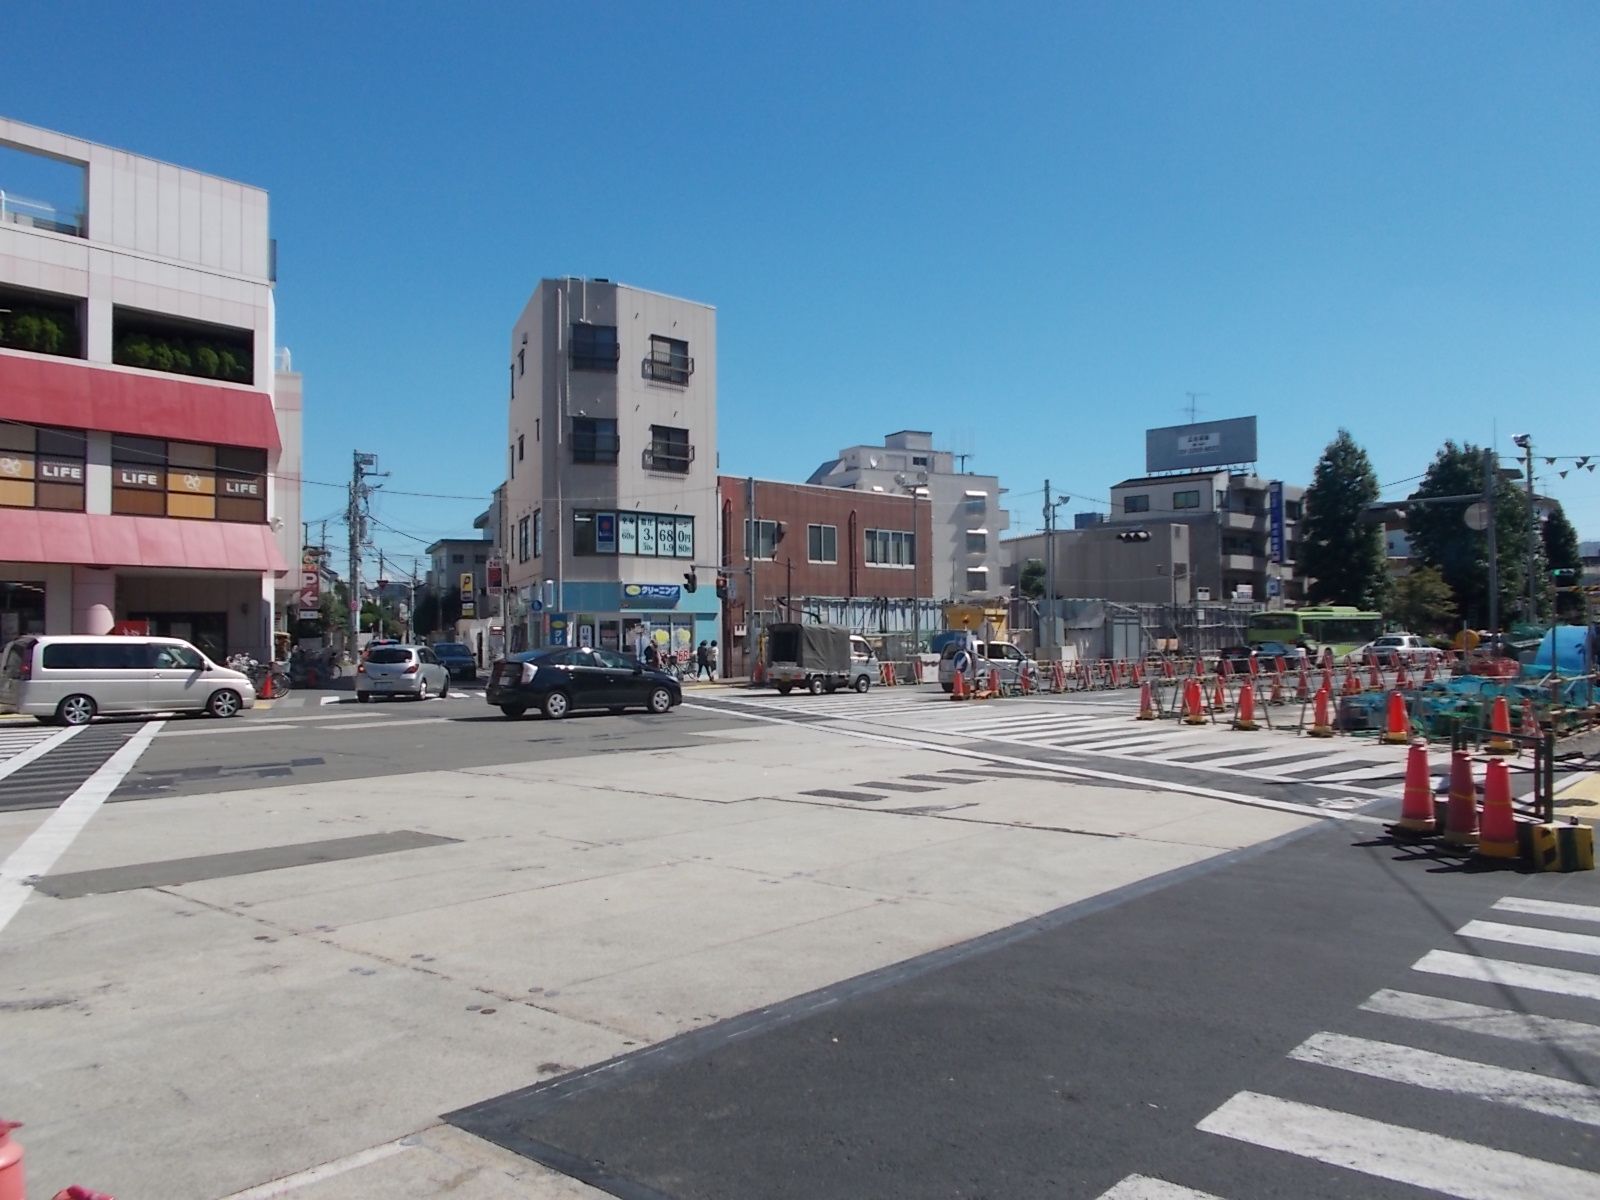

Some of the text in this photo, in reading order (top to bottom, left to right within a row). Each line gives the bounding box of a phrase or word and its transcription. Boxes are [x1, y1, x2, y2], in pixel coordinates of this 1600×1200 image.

[42, 465, 81, 479] LIFE
[121, 472, 158, 486] LIFE
[226, 482, 258, 495] LIFE
[302, 572, 318, 589] P
[641, 586, 679, 595] クリーニング
